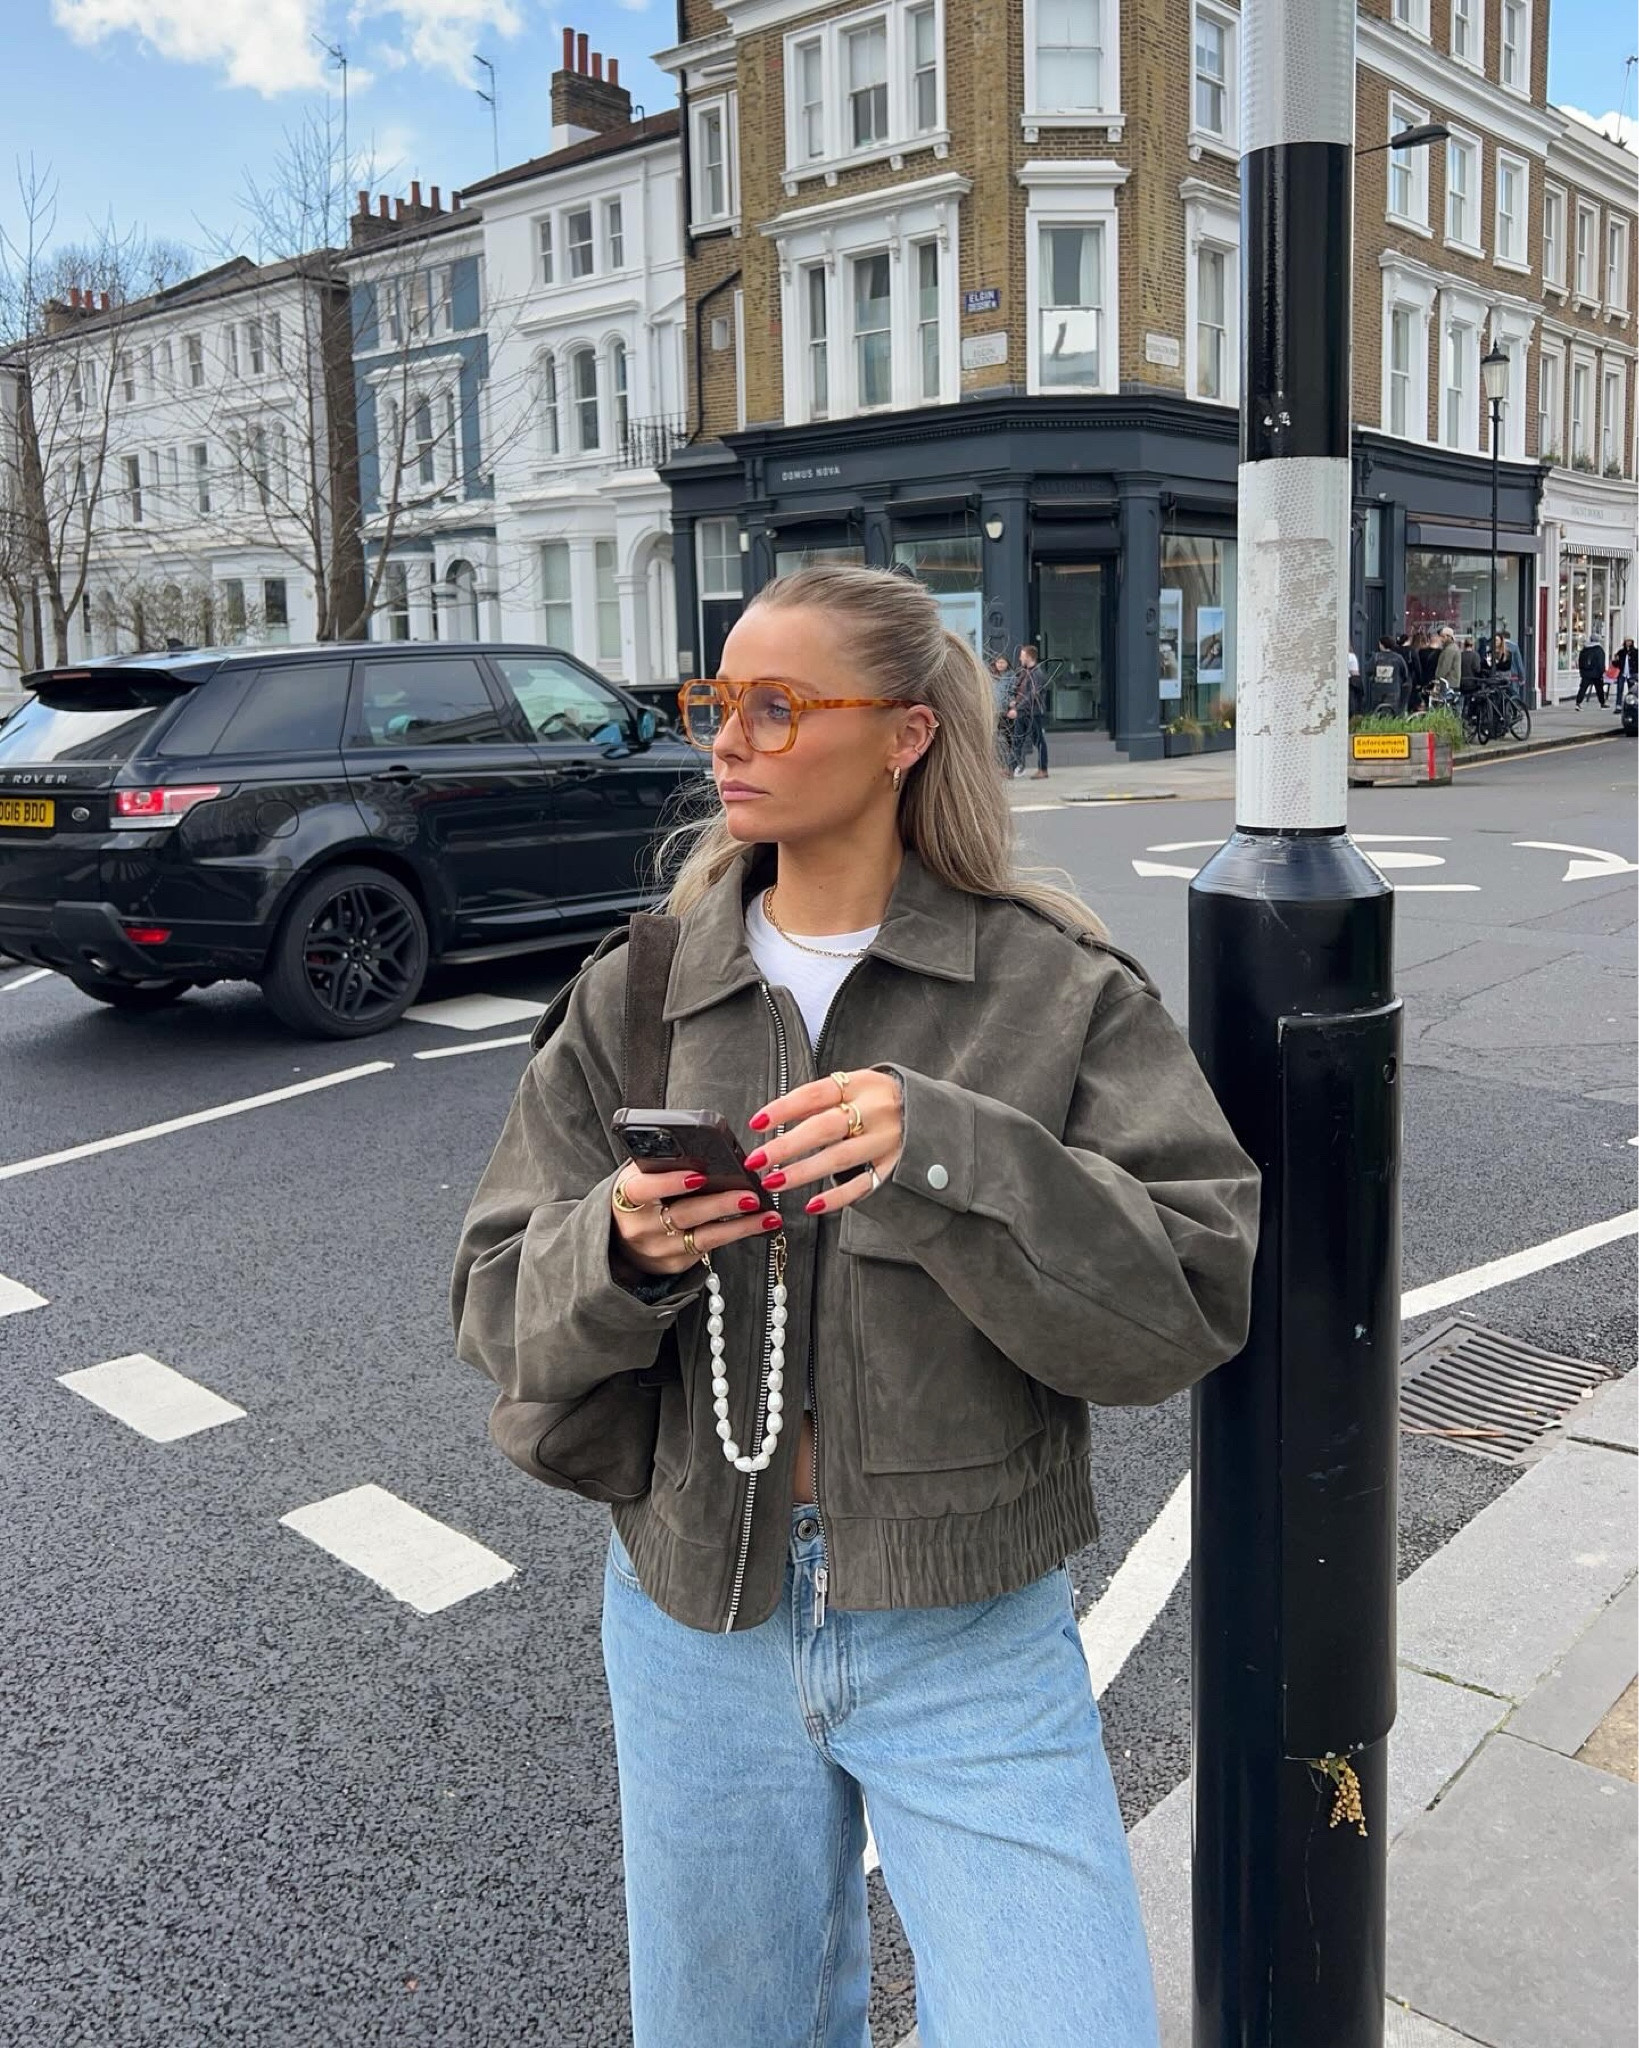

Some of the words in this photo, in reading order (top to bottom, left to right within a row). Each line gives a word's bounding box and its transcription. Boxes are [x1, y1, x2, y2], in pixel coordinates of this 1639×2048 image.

[781, 469, 813, 481] DOMUS
[815, 466, 841, 477] NOVA
[1356, 738, 1405, 746] Enforcement
[12, 774, 68, 784] ROVER
[24, 802, 47, 823] BDO
